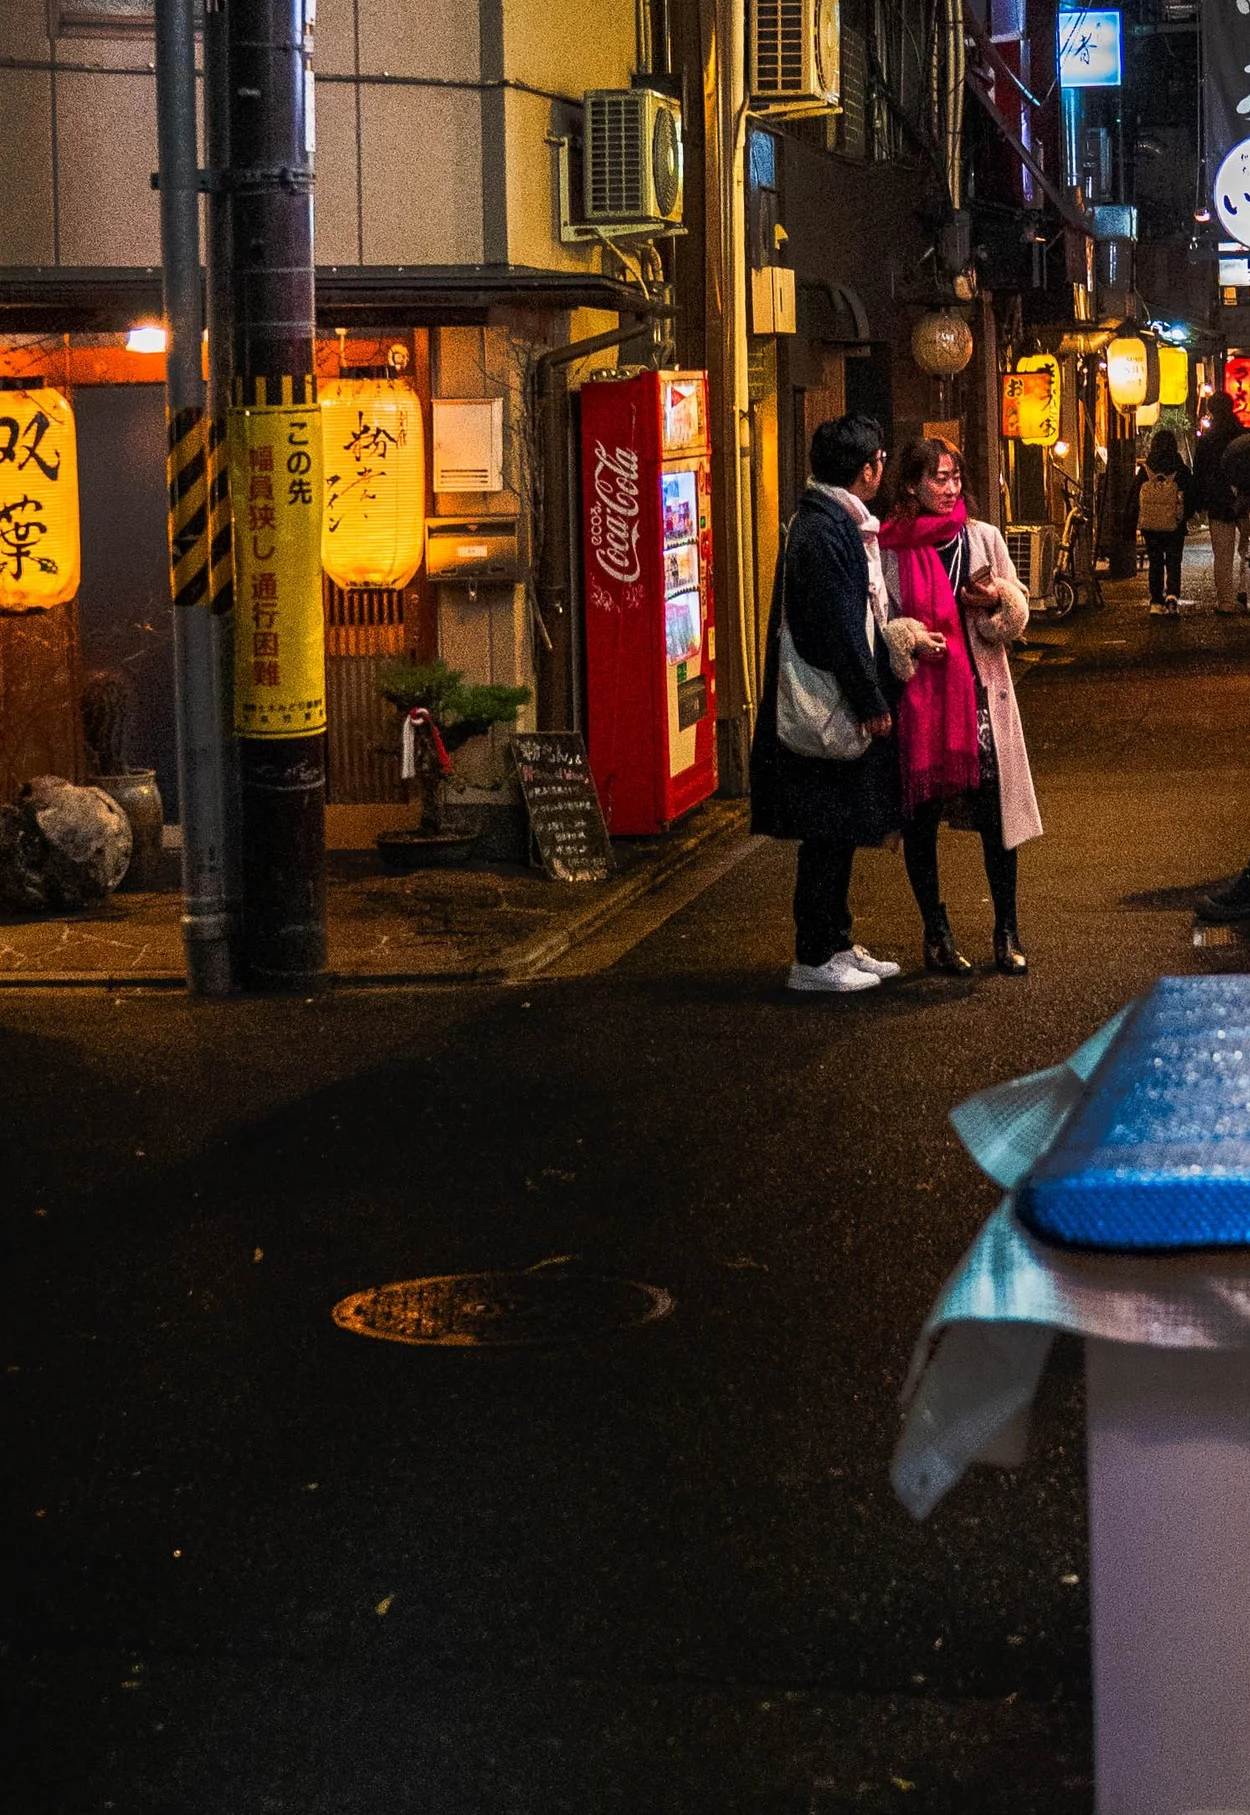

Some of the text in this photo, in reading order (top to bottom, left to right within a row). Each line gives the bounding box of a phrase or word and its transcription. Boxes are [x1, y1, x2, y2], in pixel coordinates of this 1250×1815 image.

[286, 421, 313, 506] この先
[595, 439, 641, 583] Coca-Cola
